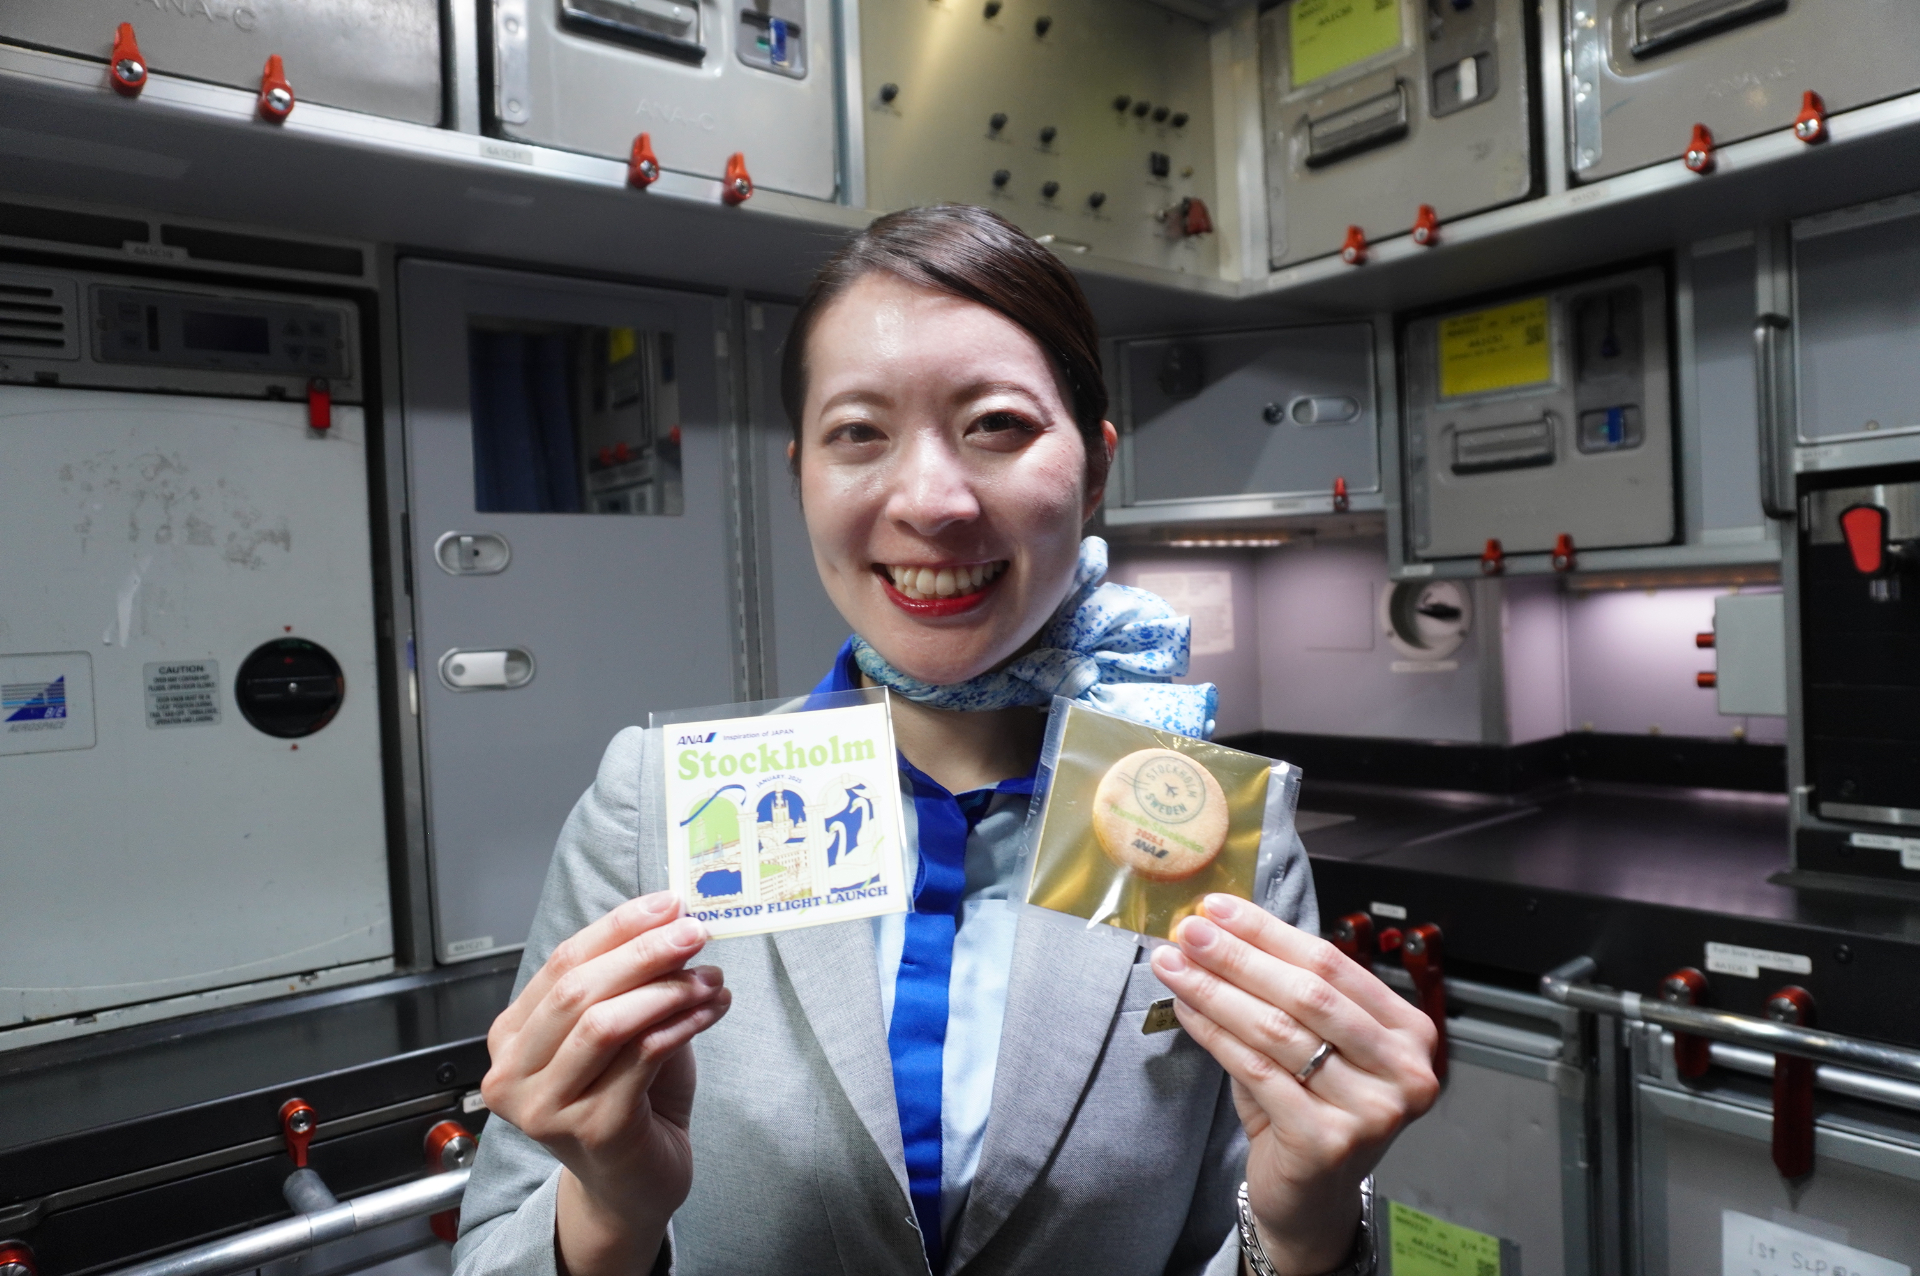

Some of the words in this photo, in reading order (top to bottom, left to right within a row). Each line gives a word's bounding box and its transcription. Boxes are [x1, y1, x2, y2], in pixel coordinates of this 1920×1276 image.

[158, 665, 204, 675] CAUTION
[677, 735, 704, 746] ANA
[723, 732, 760, 742] Inspiration
[762, 730, 769, 738] of
[771, 728, 795, 736] JAPAN
[678, 735, 876, 781] Stockholm
[1145, 763, 1198, 799] STOCKHOLM
[1145, 792, 1188, 815] SWEDEN
[1131, 838, 1157, 856] ANA
[768, 896, 822, 914] FLIGHT
[826, 885, 888, 905] LAUNCH
